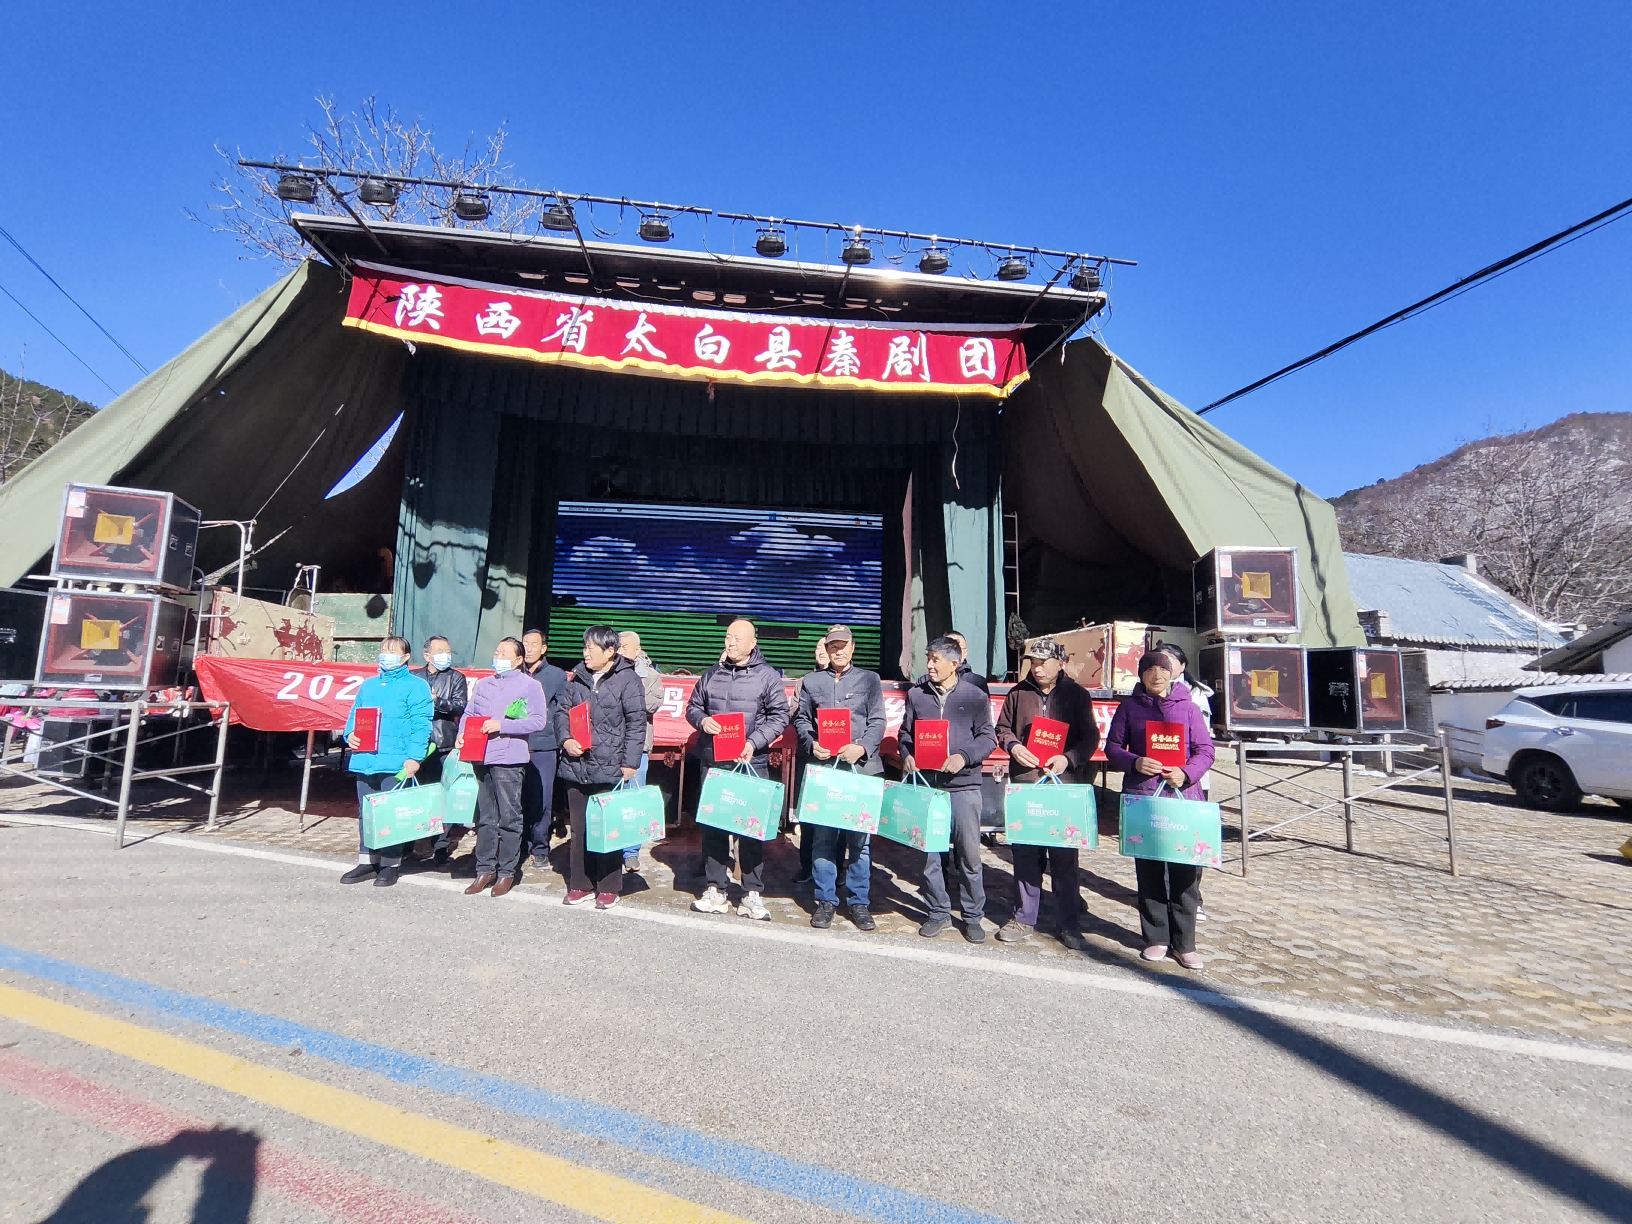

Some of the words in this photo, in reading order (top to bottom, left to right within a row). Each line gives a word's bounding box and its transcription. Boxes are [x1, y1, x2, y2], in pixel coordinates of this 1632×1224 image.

[395, 283, 997, 383] 陕西省太白县秦剧团
